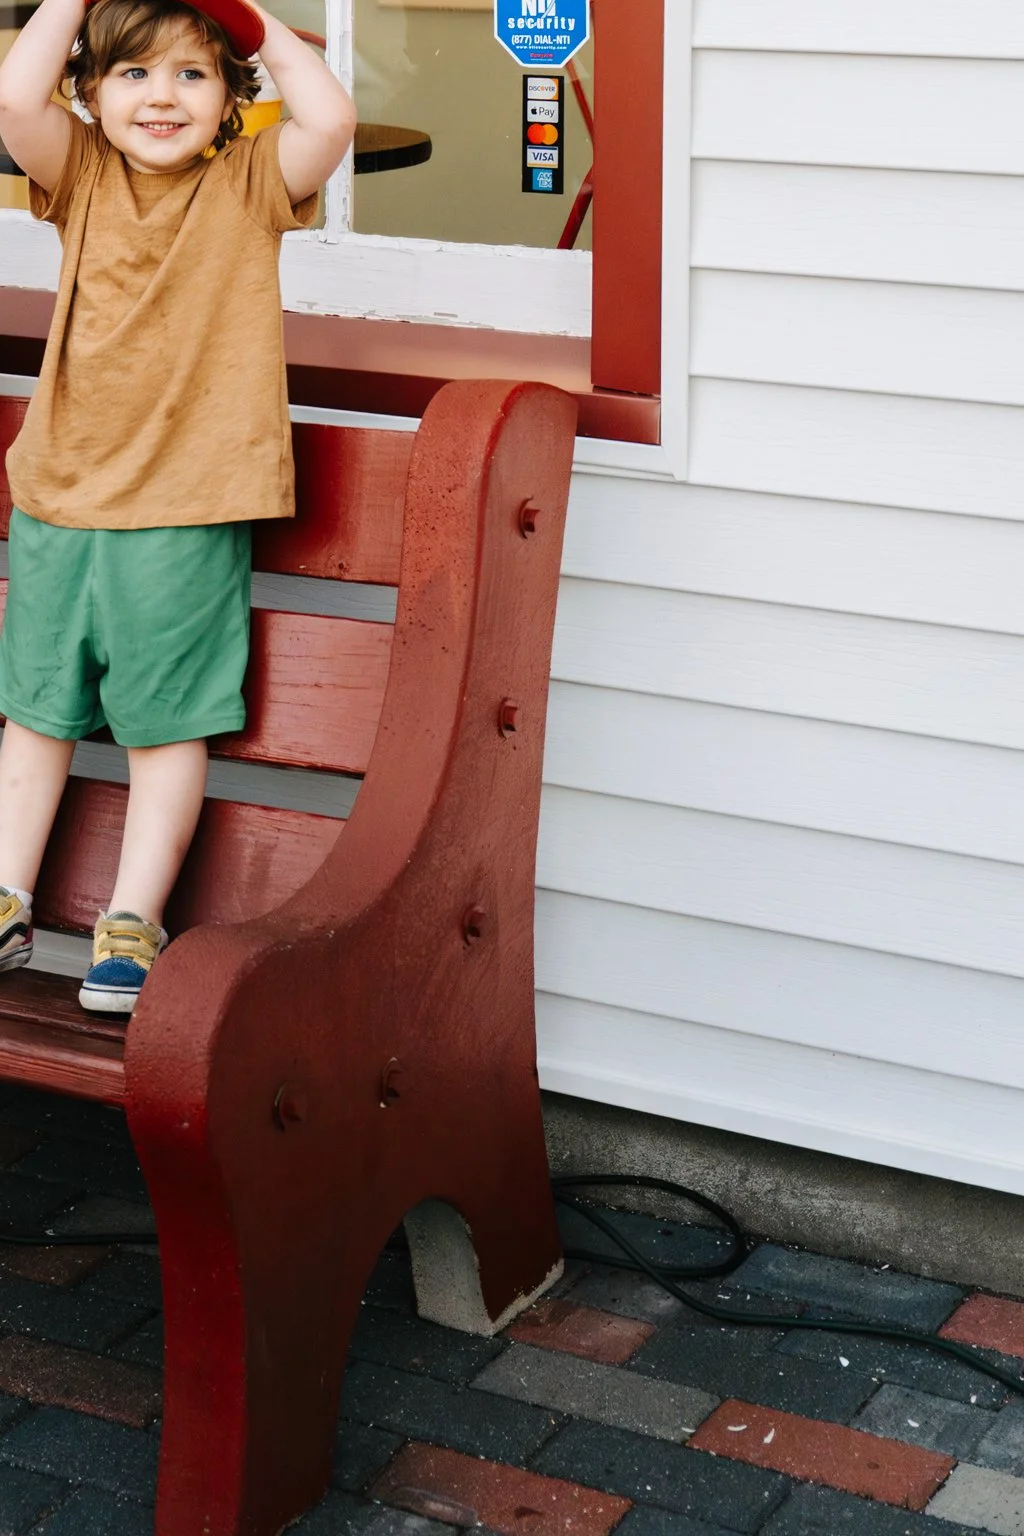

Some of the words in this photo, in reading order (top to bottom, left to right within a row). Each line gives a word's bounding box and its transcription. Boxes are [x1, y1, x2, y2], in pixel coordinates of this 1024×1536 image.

[507, 16, 576, 31] security
[511, 34, 532, 45] (877)
[534, 35, 570, 44] DIAL-NTI
[538, 107, 555, 117] Pay
[532, 152, 554, 161] VISA
